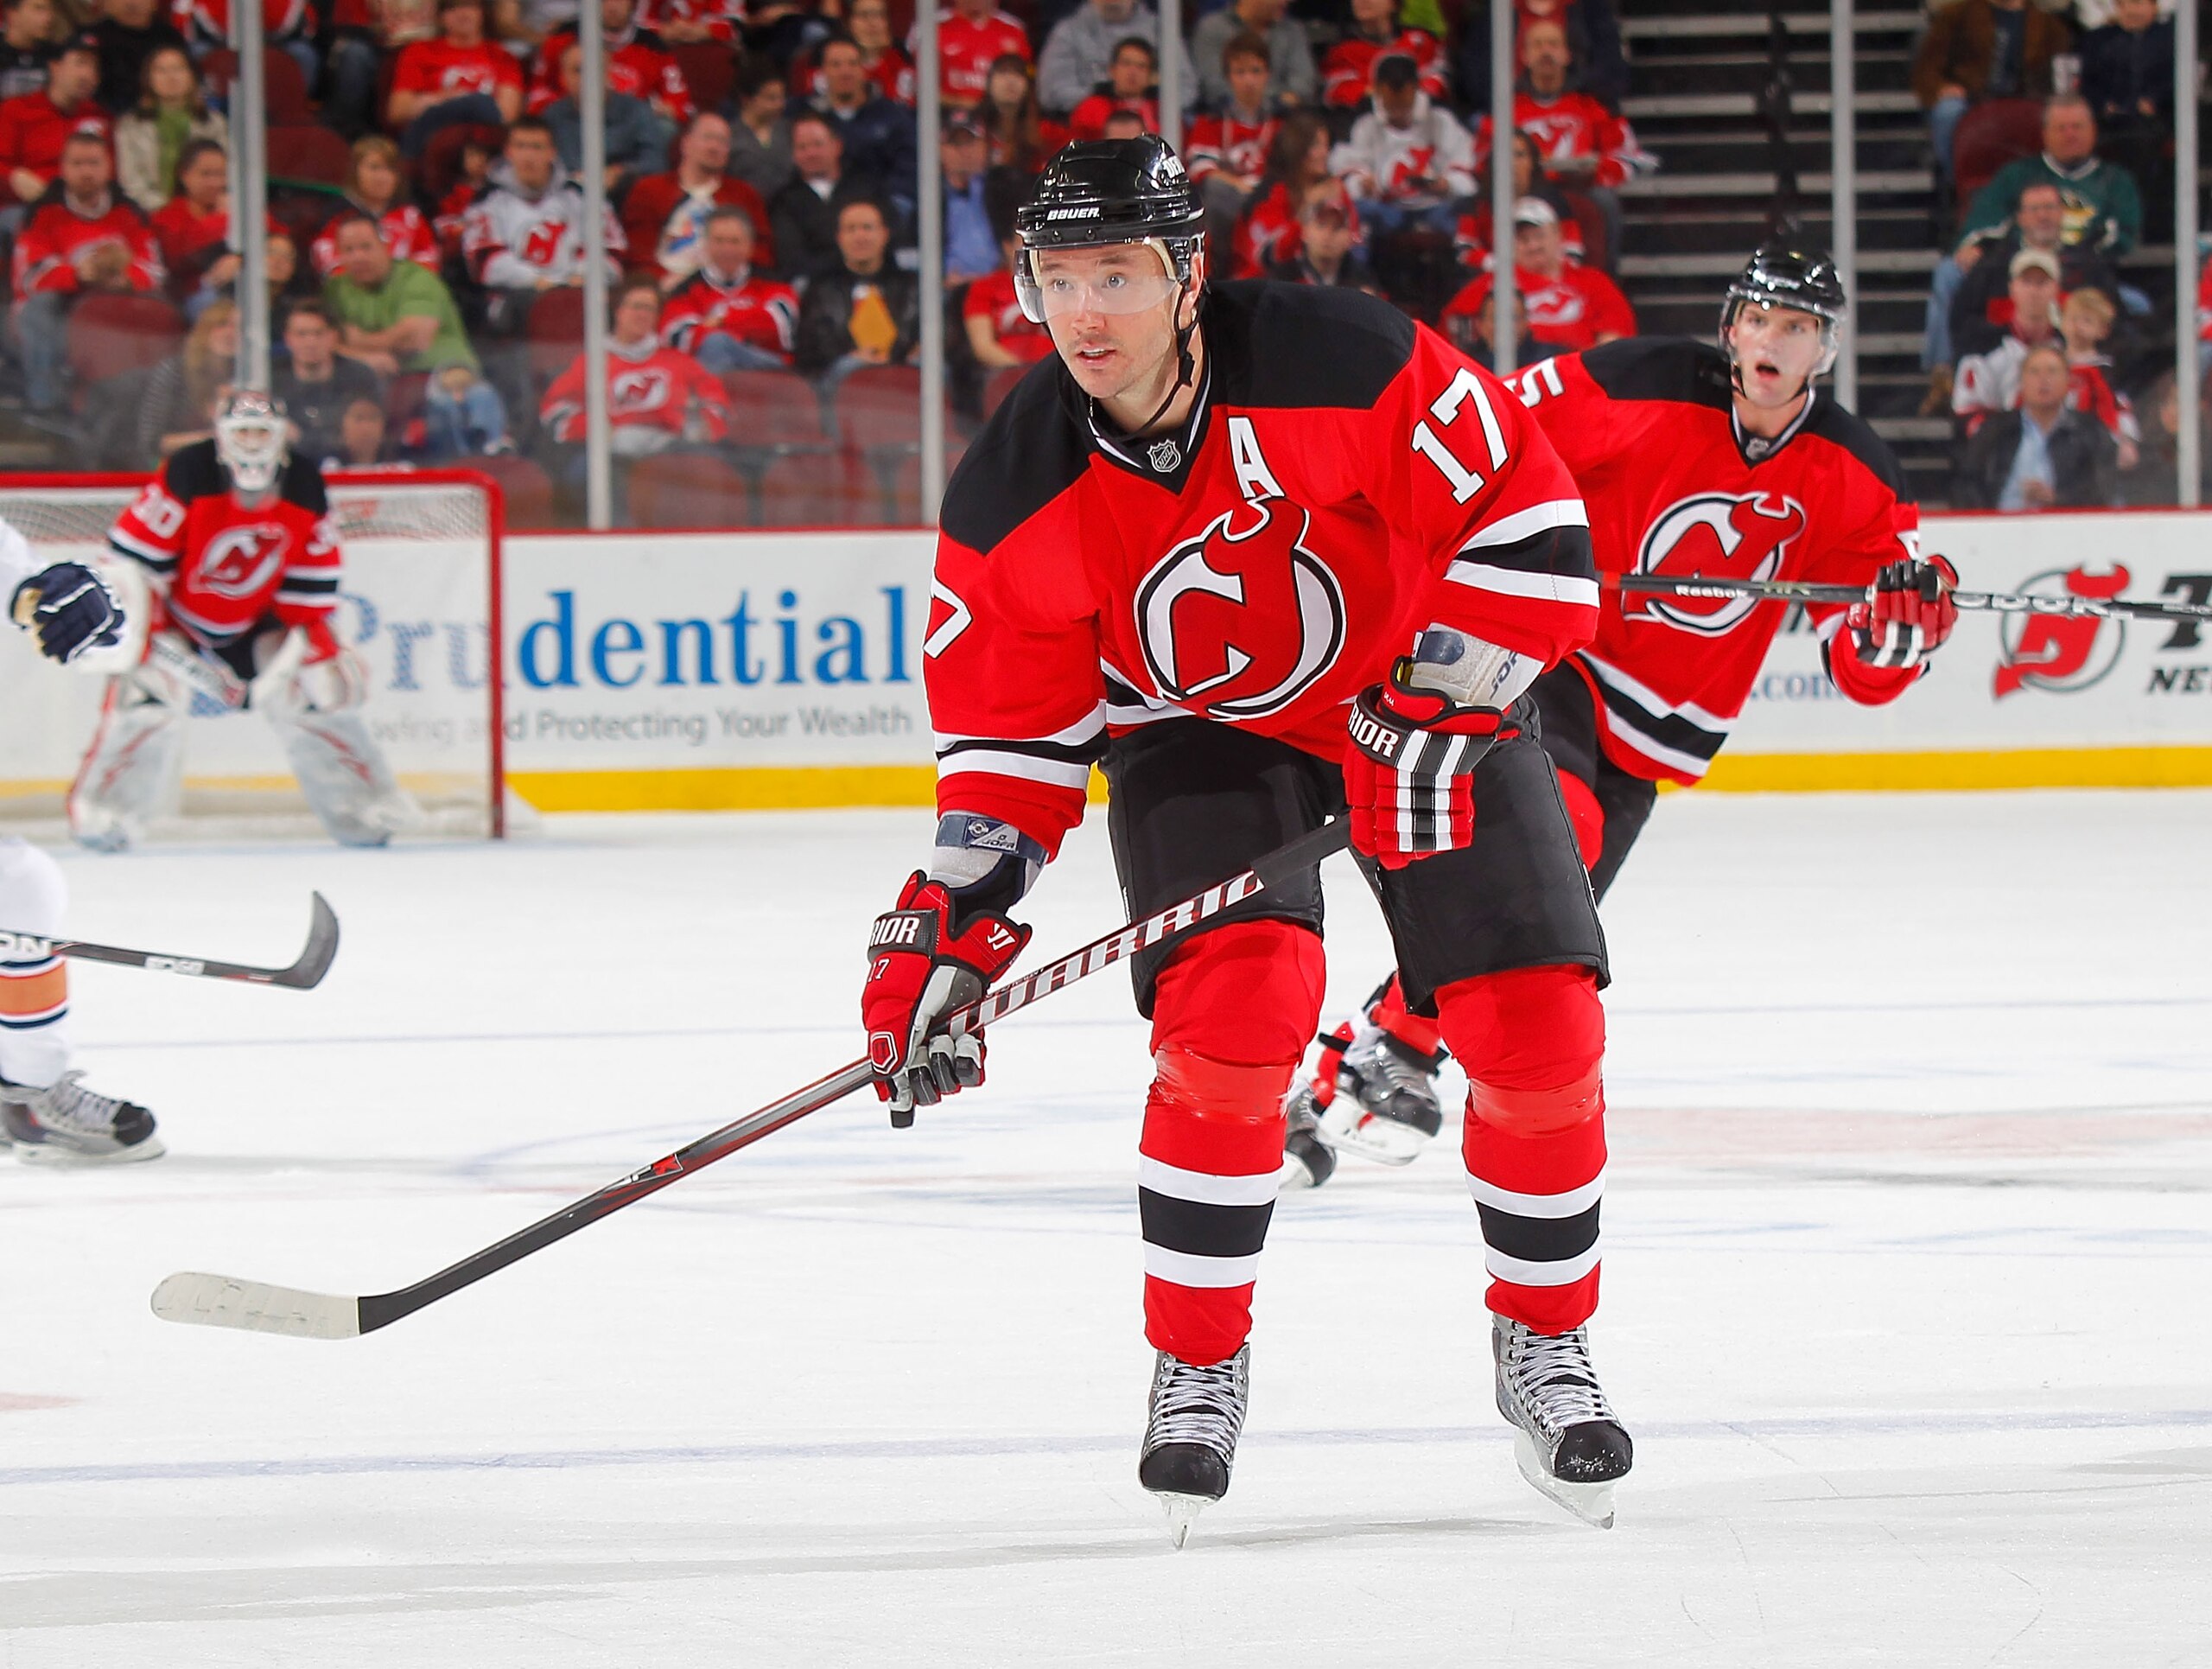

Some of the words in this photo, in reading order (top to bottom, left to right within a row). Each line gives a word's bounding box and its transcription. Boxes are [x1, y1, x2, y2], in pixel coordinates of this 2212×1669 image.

[1047, 207, 1100, 221] BAUER
[1411, 366, 1510, 505] 17
[1226, 416, 1287, 499] A
[1675, 584, 1749, 598] Reebok
[2151, 666, 2212, 691] NE
[537, 709, 708, 748] Protecting
[715, 705, 790, 736] Your
[798, 702, 913, 736] Wealth
